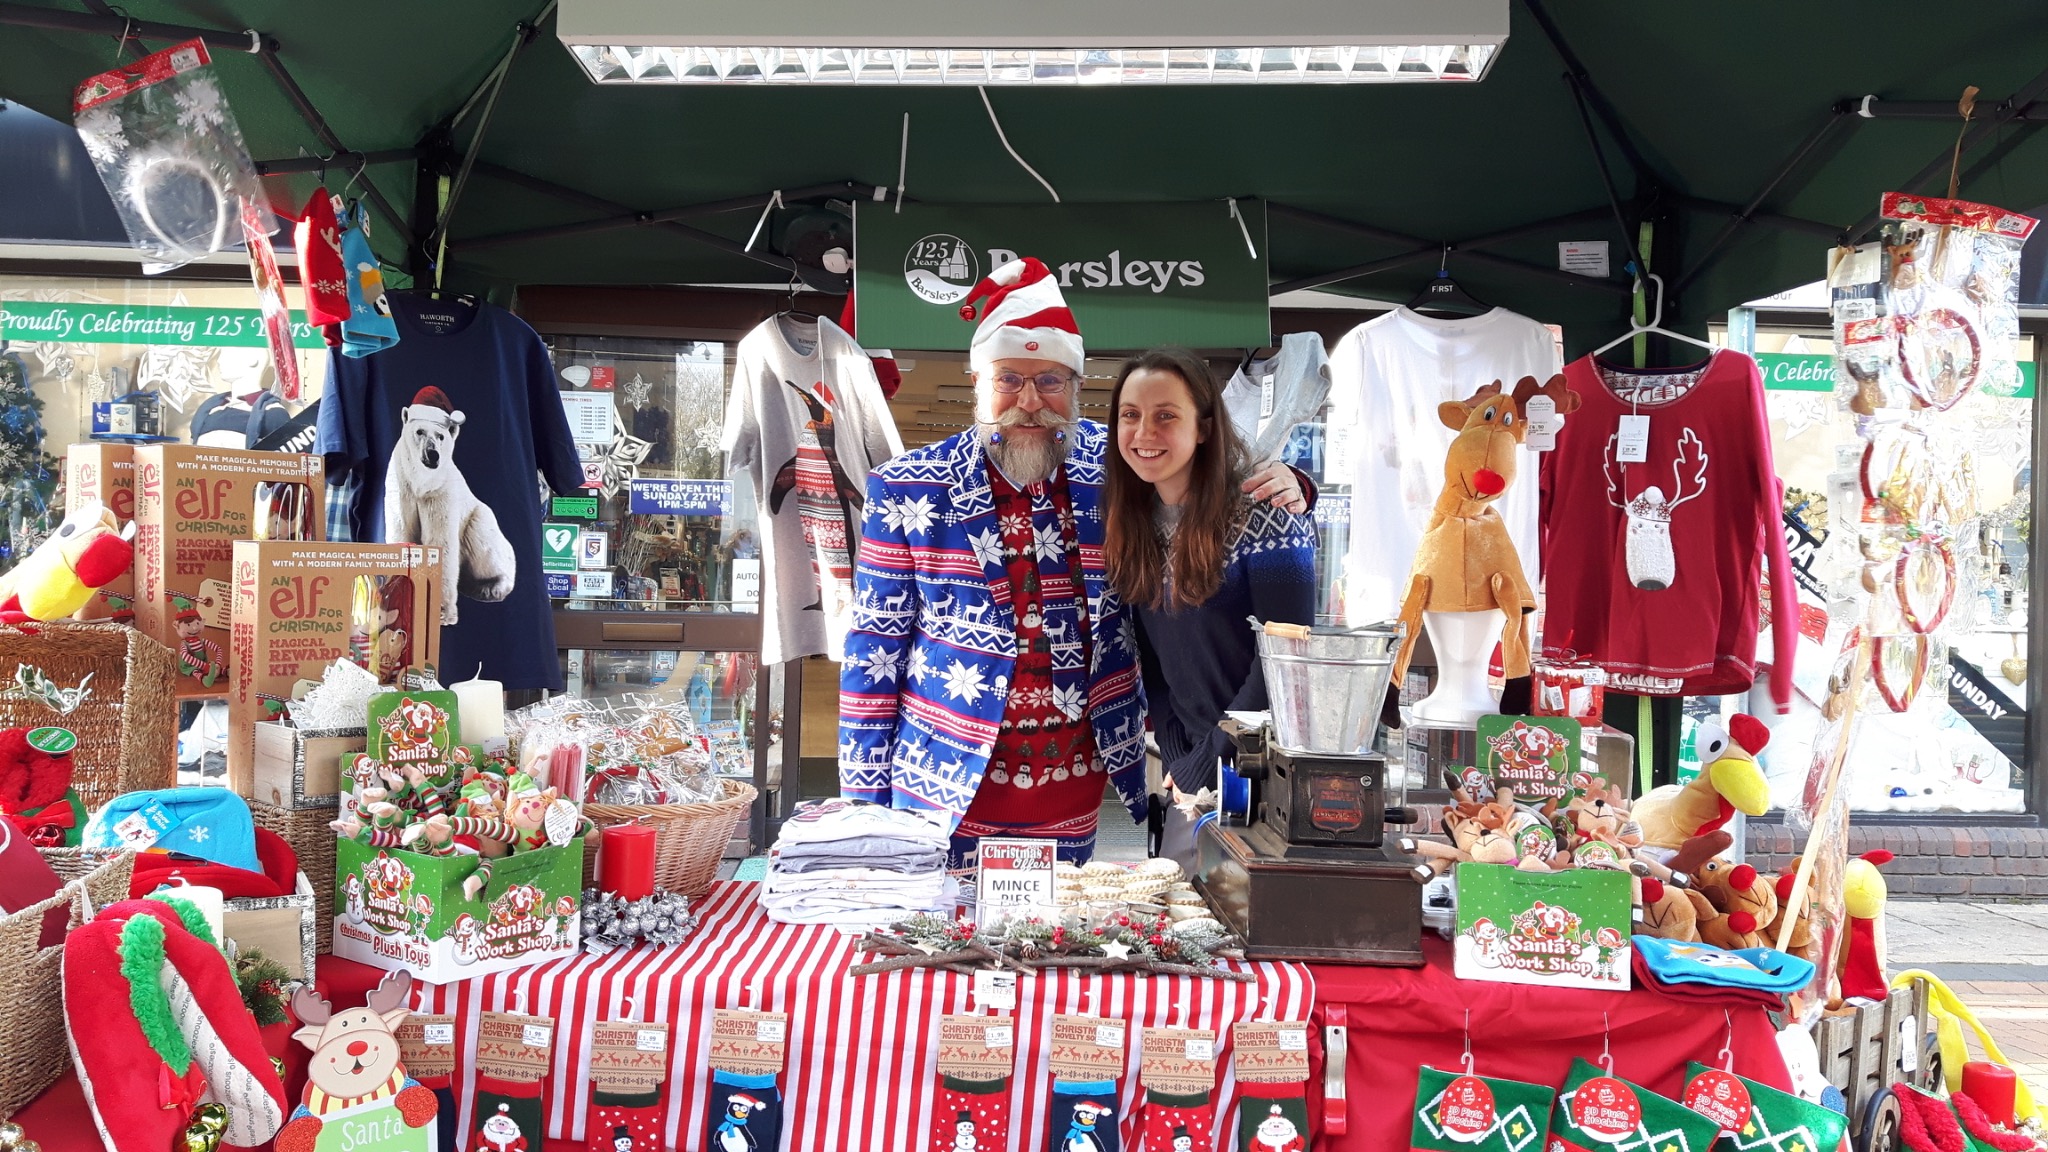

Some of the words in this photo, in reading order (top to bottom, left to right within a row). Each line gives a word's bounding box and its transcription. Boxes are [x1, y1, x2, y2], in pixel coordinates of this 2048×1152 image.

[915, 241, 949, 259] 125
[911, 257, 940, 267] Years
[987, 248, 1205, 294] Brsleys
[910, 276, 959, 302] Barsleys
[1431, 284, 1454, 293] FIRST
[420, 313, 455, 323] HAWORTH
[0, 309, 74, 338] Proudly
[79, 310, 196, 342] Celebrating
[201, 314, 245, 337] 125
[250, 316, 312, 338] Yrs
[175, 461, 199, 470] WITH
[210, 463, 245, 473] MODERN
[246, 466, 274, 475] FAMILY
[195, 454, 220, 463] MAKE
[221, 456, 257, 465] MAGICAL
[259, 458, 298, 468] MEMORIES
[111, 477, 131, 489] AN
[143, 463, 161, 506] elf
[175, 477, 196, 489] AN
[631, 483, 668, 492] WE'RE
[670, 483, 702, 493] OPEN
[705, 484, 732, 494] THIS
[174, 478, 233, 520] elf
[642, 491, 689, 500] SUNDAY
[692, 492, 721, 502] 27TH
[656, 500, 707, 510] 1PM-5PM
[222, 509, 247, 521] FOR
[1316, 515, 1350, 523] M-5PM
[175, 521, 247, 536] CHRISTMAS
[138, 524, 146, 555] KIT
[175, 538, 231, 549] MAGICAL
[175, 549, 234, 562] REWAR
[291, 551, 317, 559] MAKE
[319, 551, 356, 560] MAGICAL
[358, 552, 400, 560] MEMORIES
[146, 523, 155, 603] REWARD
[175, 562, 206, 575] KIT
[271, 560, 295, 568] WITH
[297, 560, 304, 568] A
[310, 560, 342, 568] MODERN
[344, 560, 373, 569] FAMILY
[240, 560, 255, 605] elf
[270, 575, 291, 587] AN
[548, 576, 569, 584] Shop
[735, 573, 759, 581] AUTO
[269, 575, 330, 619] elf
[746, 590, 759, 598] DO
[318, 607, 343, 618] FOR
[269, 620, 344, 634] CHRISTMAS
[268, 637, 326, 649] MAGICAL
[246, 624, 254, 686] MAGICAL
[268, 648, 342, 662] REWARD
[239, 622, 247, 705] REWARD
[268, 663, 300, 677] KIT
[1945, 663, 2008, 721] SUNDAY
[388, 745, 439, 761] Santa's
[416, 762, 448, 778] Shop
[1499, 763, 1557, 781] Santa's
[1530, 782, 1566, 800] Shop
[984, 845, 1043, 859] Christmas
[1012, 857, 1052, 872] Offers
[992, 880, 1040, 892] MINCE
[368, 891, 406, 915] Santa's
[1001, 894, 1031, 906] PIES
[362, 907, 386, 925] Work
[387, 913, 411, 933] Shop
[485, 919, 545, 941] Santa's
[340, 923, 371, 941] Christmas
[373, 935, 403, 957] Plush
[404, 943, 430, 967] Toys
[476, 941, 515, 960] Work
[517, 935, 552, 952] Shop
[1508, 935, 1582, 957] Santa's
[1498, 953, 1545, 969] Work
[1548, 956, 1593, 977] Shop
[483, 1021, 523, 1032] CHRISTM
[715, 1019, 758, 1030] CHRISTM
[715, 1027, 745, 1035] NOVELTY
[942, 1024, 986, 1034] CHRISTM
[1055, 1024, 1097, 1035] CHRISTM
[482, 1029, 513, 1038] NOVELTY
[594, 1030, 637, 1039] CHRISTM
[1055, 1032, 1085, 1041] NOVELTY
[1085, 1034, 1096, 1042] SO
[1236, 1031, 1279, 1040] CHRISTM
[594, 1038, 625, 1046] NOVELTY
[626, 1038, 637, 1046] SO
[1144, 1038, 1186, 1047] CHRISTM
[1144, 1045, 1174, 1053] NOVELTY
[1448, 1105, 1460, 1116] 3D
[1461, 1106, 1484, 1120] Plush
[1583, 1106, 1599, 1116] 3D
[1601, 1106, 1629, 1121] Plush
[1695, 1093, 1711, 1106] 3D
[1711, 1099, 1738, 1121] Plush
[1446, 1114, 1483, 1129] Stocking
[1693, 1101, 1735, 1129] Stocking
[1583, 1115, 1629, 1130] Stocking
[341, 1114, 404, 1152] Santa
